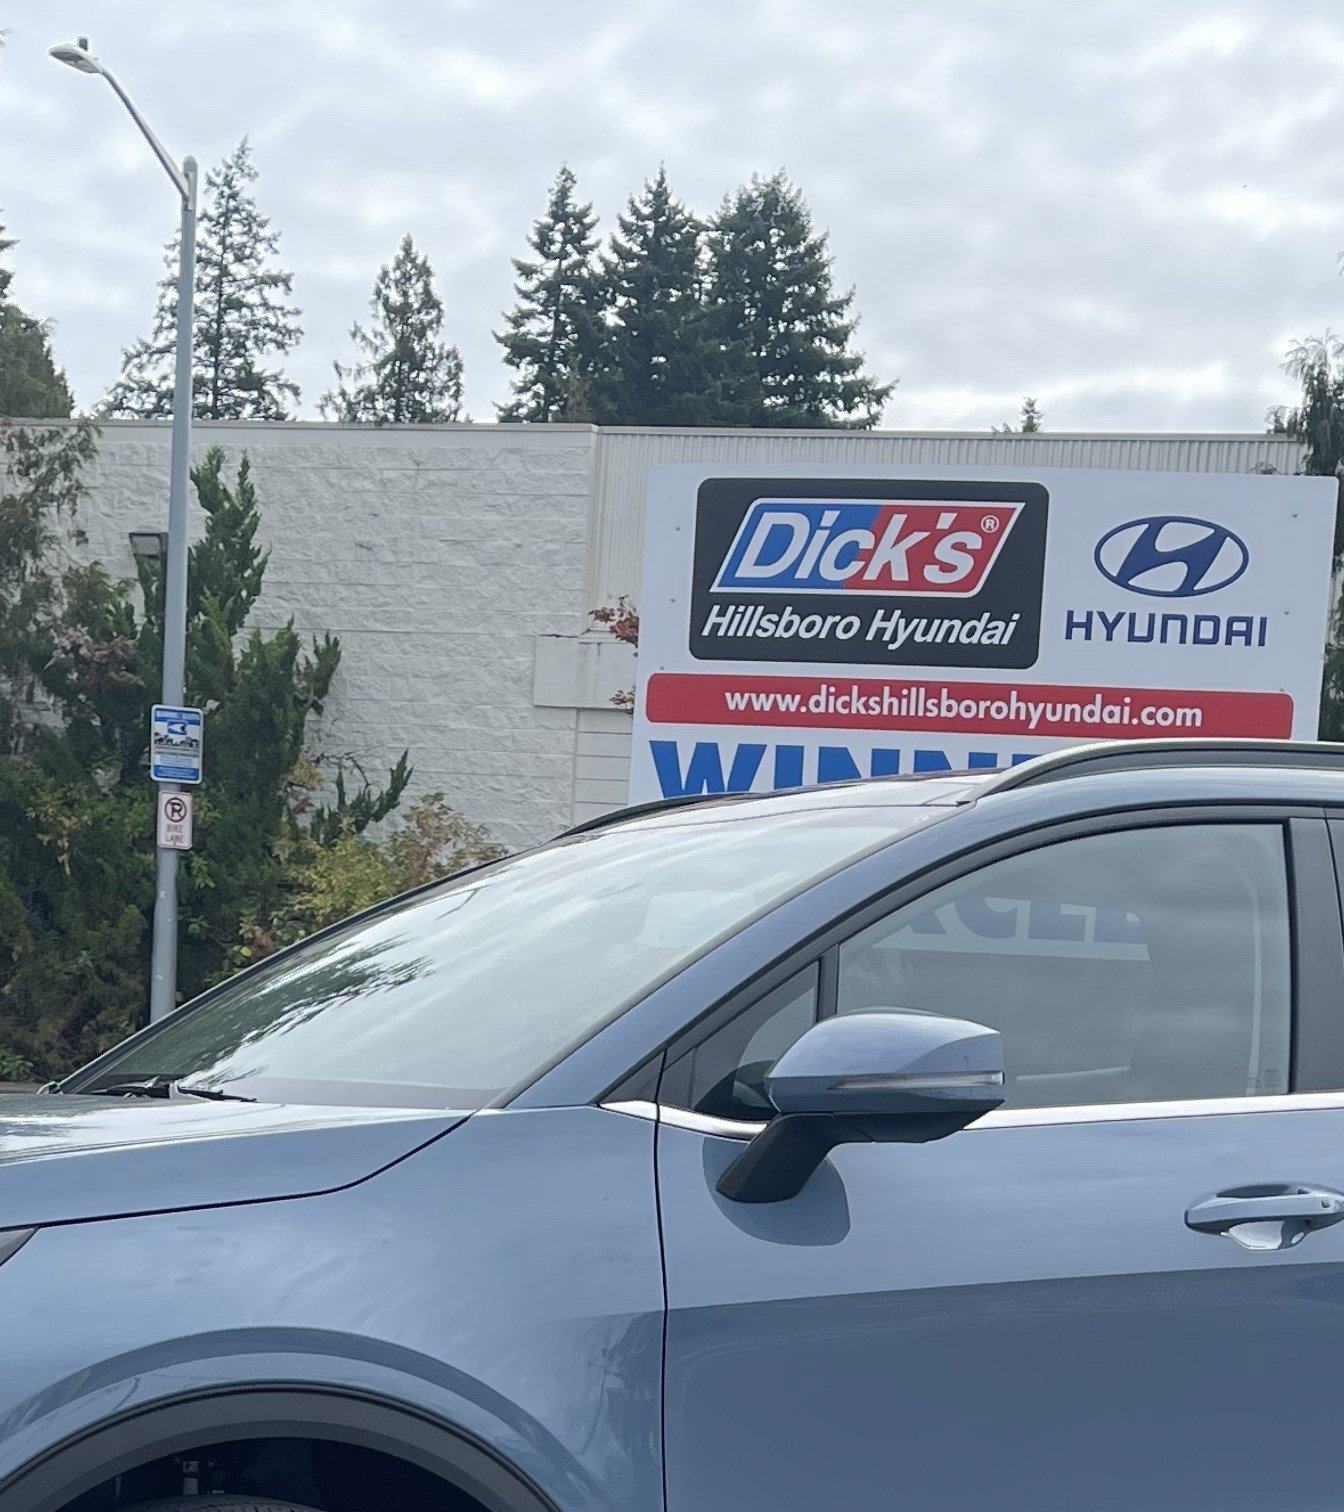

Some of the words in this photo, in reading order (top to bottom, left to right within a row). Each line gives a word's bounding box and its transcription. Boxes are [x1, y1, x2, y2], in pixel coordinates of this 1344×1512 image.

[736, 507, 984, 585] Dick's
[702, 604, 860, 642] Hillsboro
[865, 608, 1020, 651] Hyundai
[1064, 609, 1268, 649] HYUNDAI
[725, 683, 1204, 730] www.dickshillsborohyundai.com
